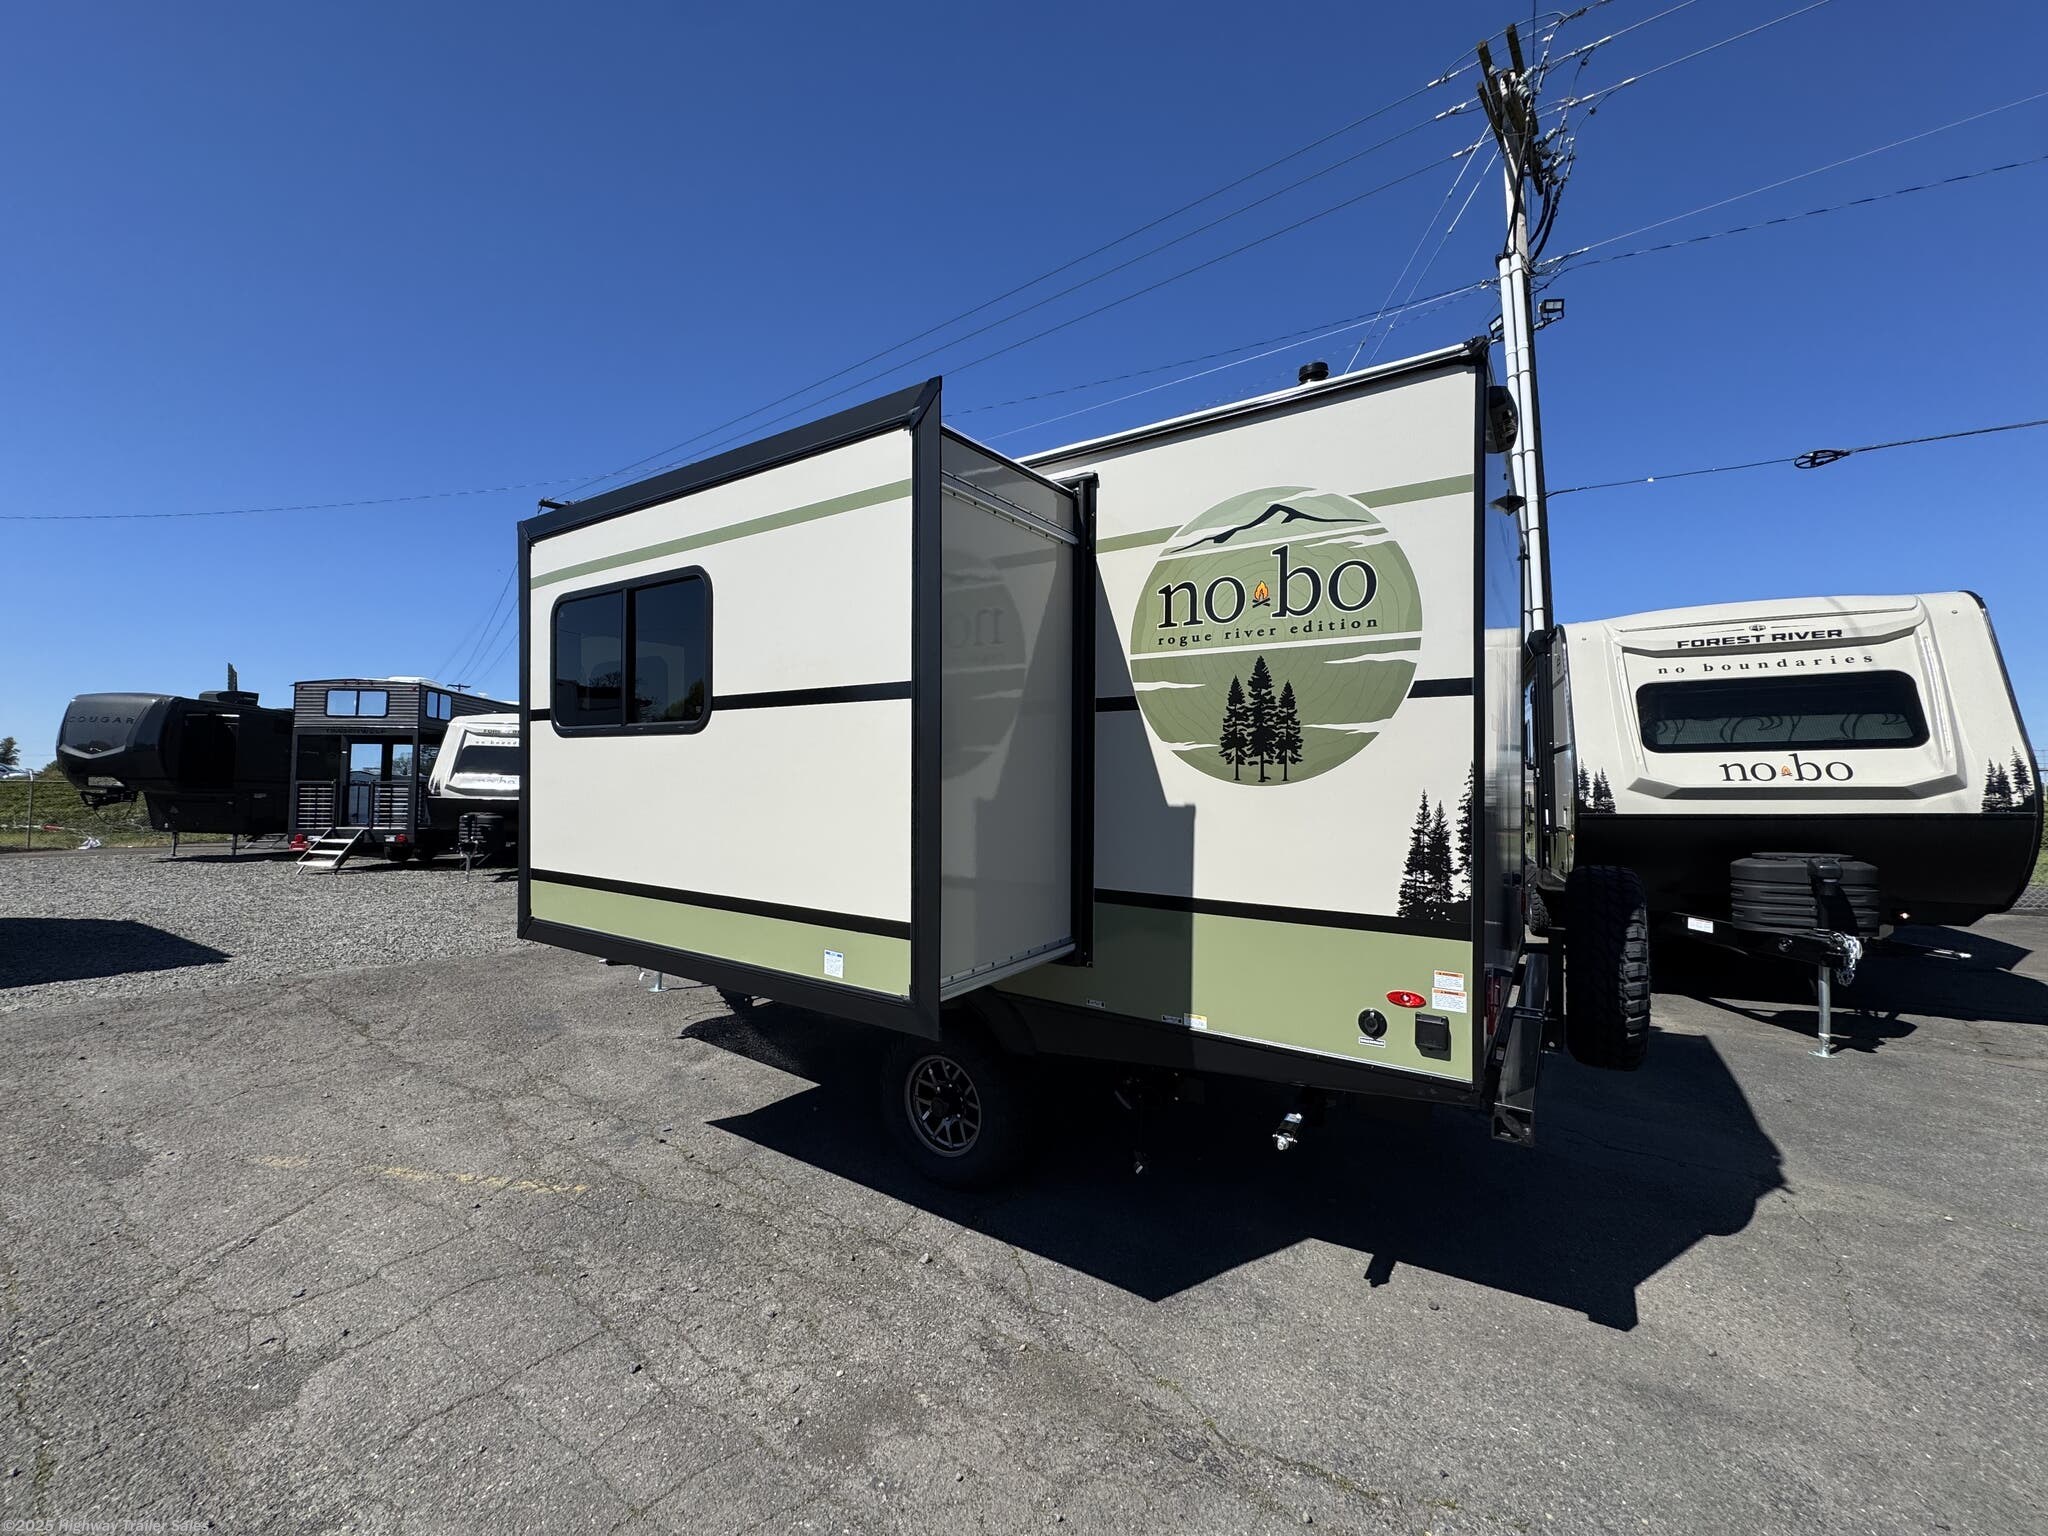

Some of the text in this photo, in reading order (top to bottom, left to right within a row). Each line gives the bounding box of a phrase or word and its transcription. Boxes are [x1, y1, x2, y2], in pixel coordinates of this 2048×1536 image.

[1158, 618, 1378, 647] rogue river edition
[1677, 629, 1843, 649] FOREST RIVER
[1658, 655, 1873, 674] no boundaries
[68, 715, 135, 724] COUGAR
